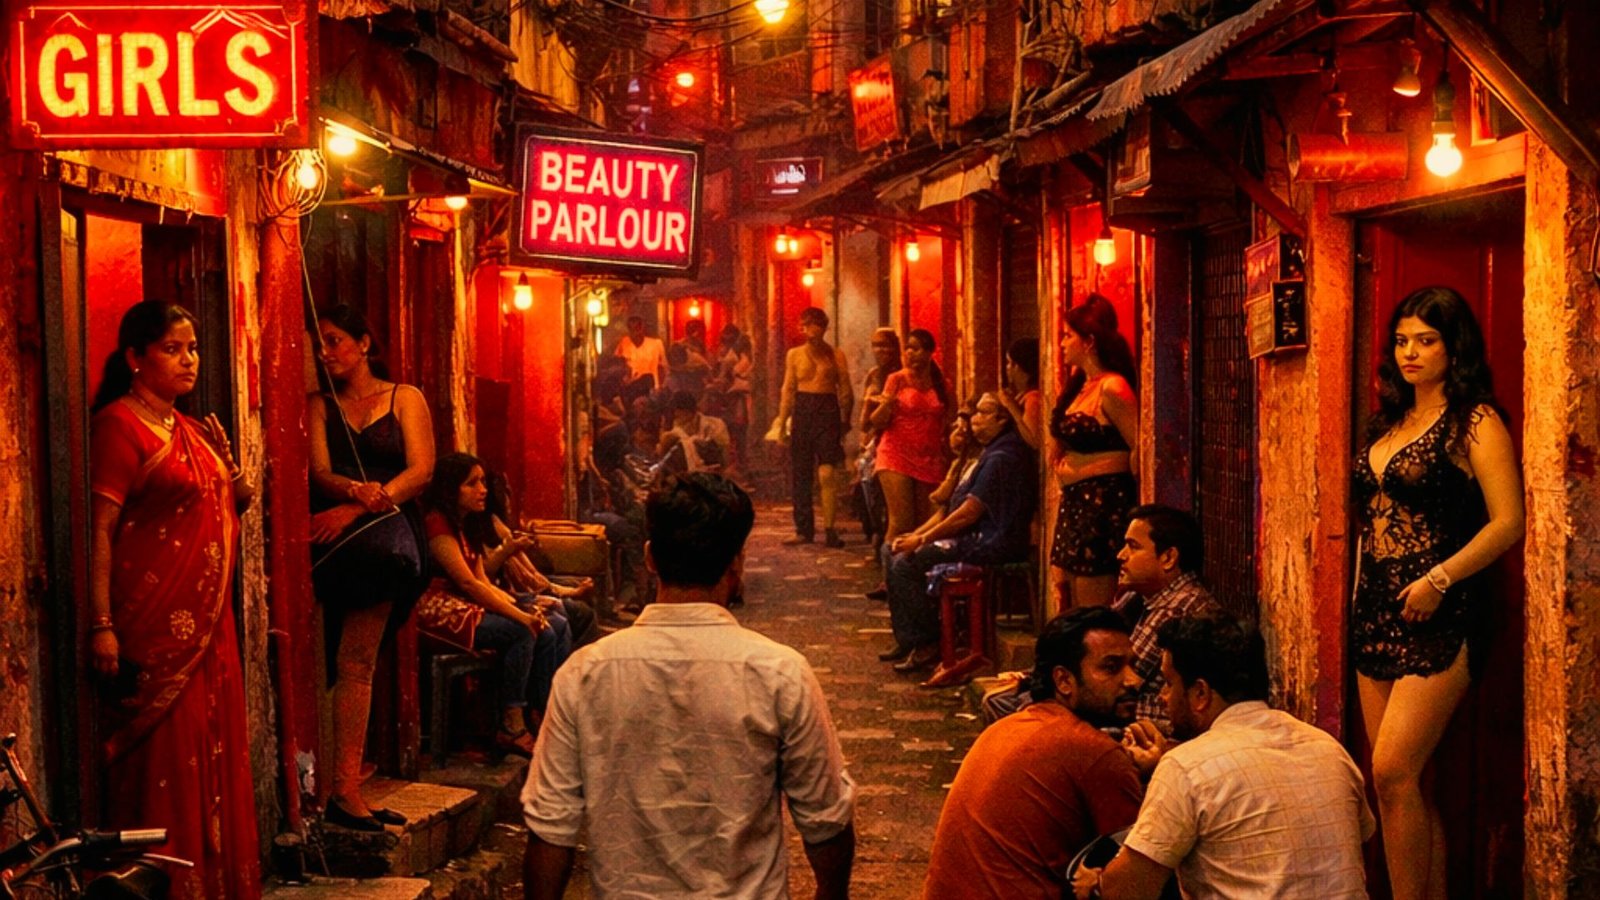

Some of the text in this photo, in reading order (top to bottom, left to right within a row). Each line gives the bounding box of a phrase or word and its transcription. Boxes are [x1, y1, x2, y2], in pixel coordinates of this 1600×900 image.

[38, 31, 275, 117] GIRLS
[540, 151, 679, 202] BEAUTY
[530, 199, 686, 253] PARLOUR
